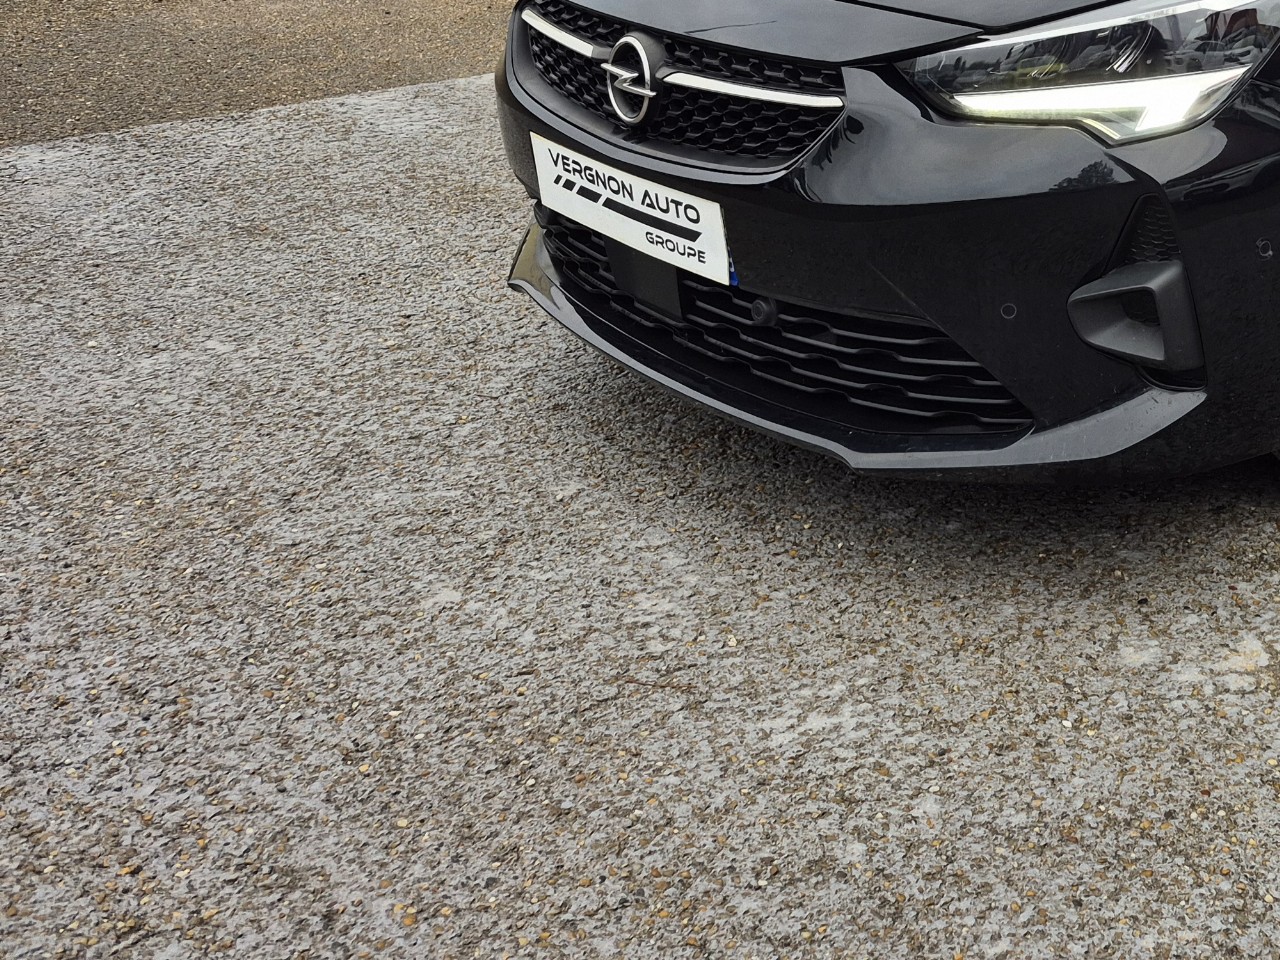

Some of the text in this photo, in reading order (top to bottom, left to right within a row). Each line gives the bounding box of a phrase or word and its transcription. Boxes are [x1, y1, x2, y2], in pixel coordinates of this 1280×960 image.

[548, 148, 701, 224] VERGNON AUTO
[645, 231, 707, 265] GROUPE
